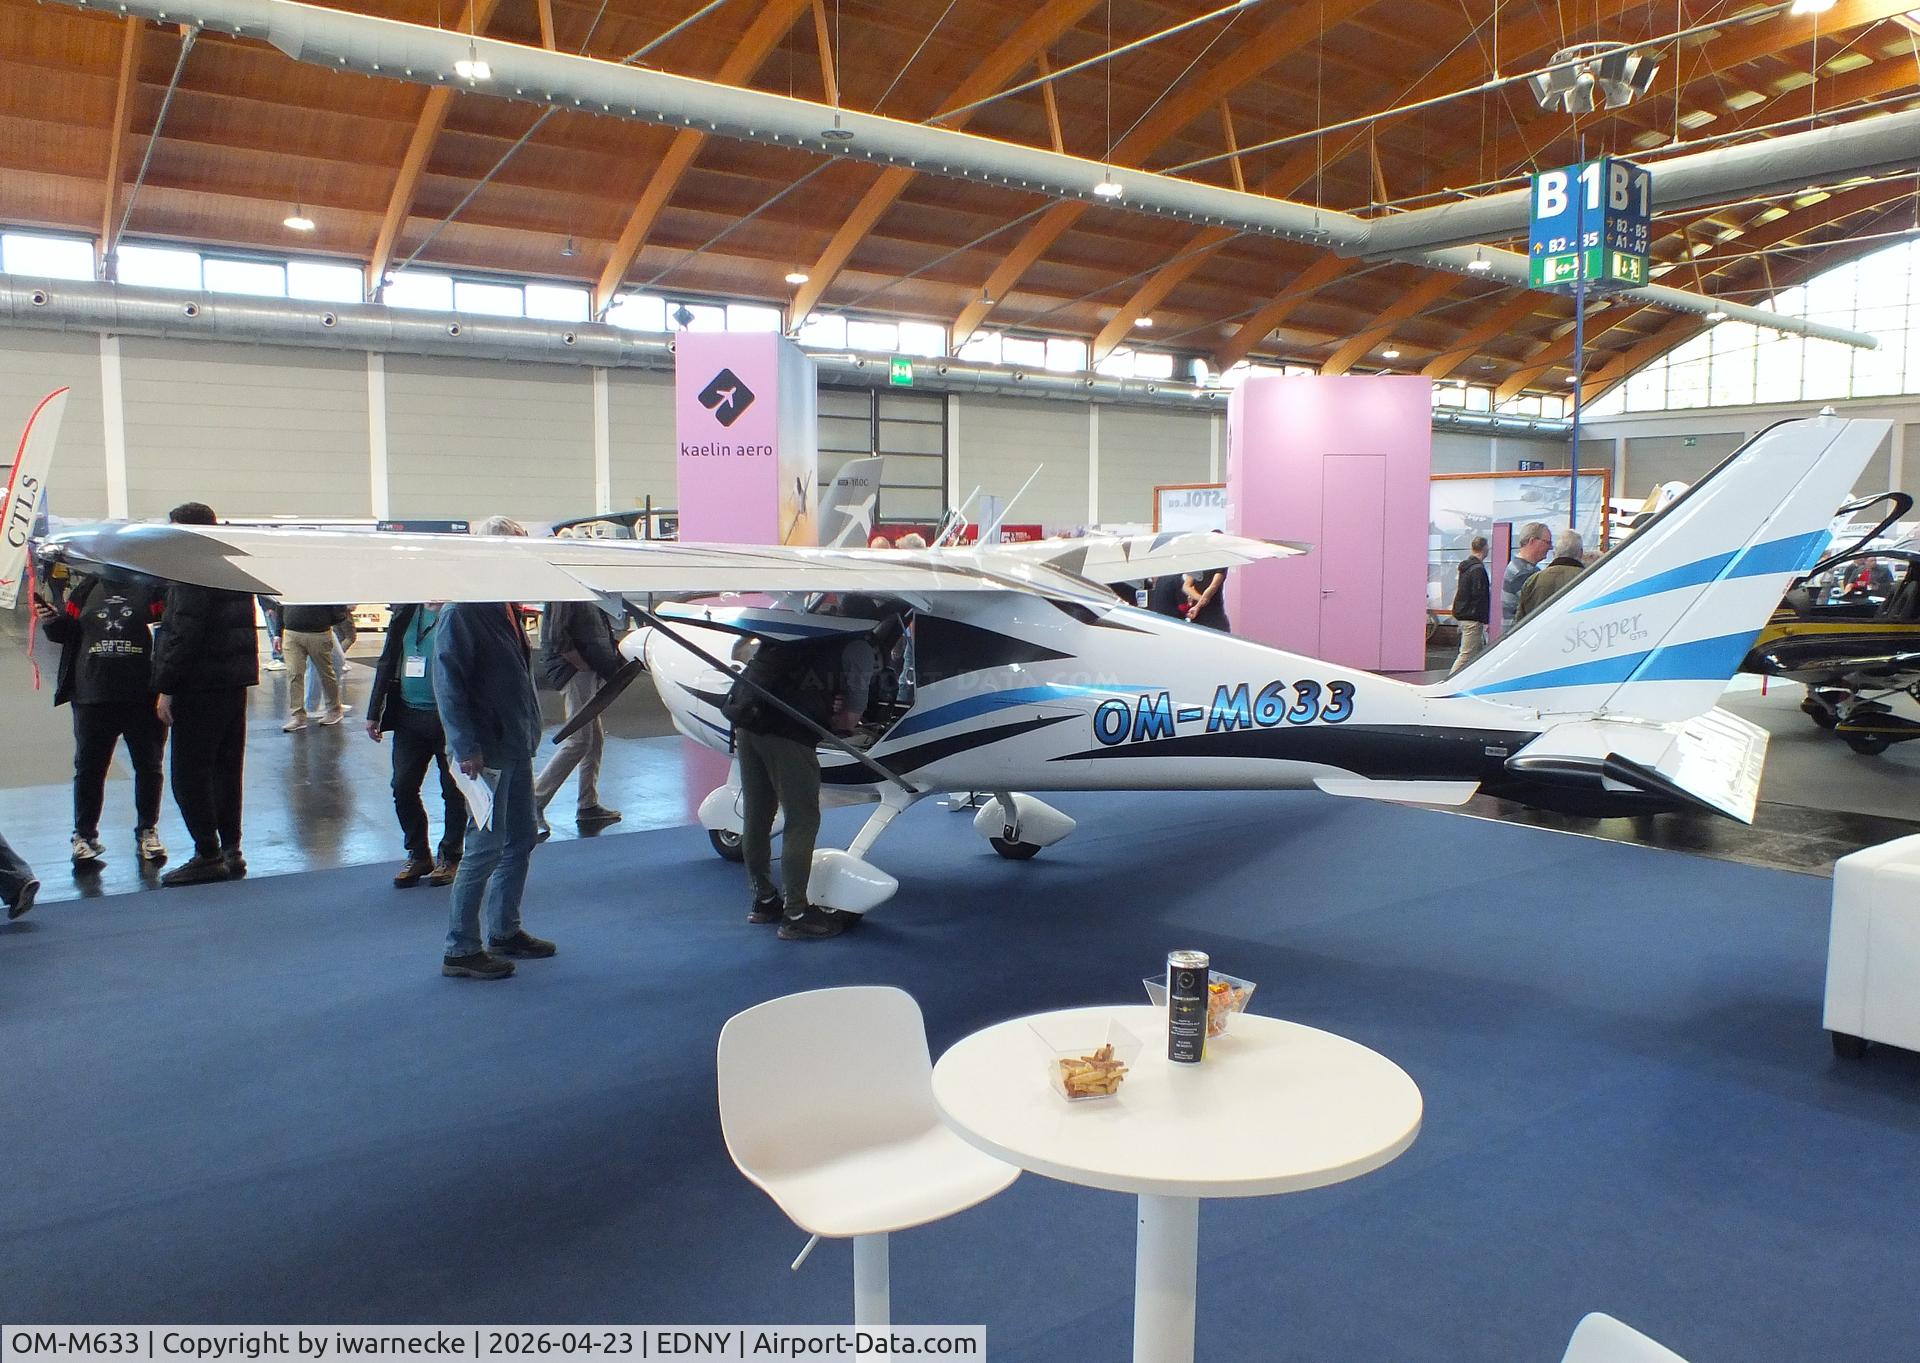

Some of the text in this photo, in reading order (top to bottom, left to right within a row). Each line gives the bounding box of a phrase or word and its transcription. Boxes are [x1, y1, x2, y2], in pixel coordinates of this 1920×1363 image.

[1617, 219, 1627, 232] B2
[1635, 224, 1647, 239] B5
[1549, 237, 1566, 253] B2
[1616, 235, 1627, 249] A1
[1634, 239, 1647, 253] A7
[681, 442, 773, 457] kaelin aero
[8, 474, 38, 548] CTLS
[1562, 613, 1642, 653] Skyper
[1093, 680, 1355, 745] OM-M633
